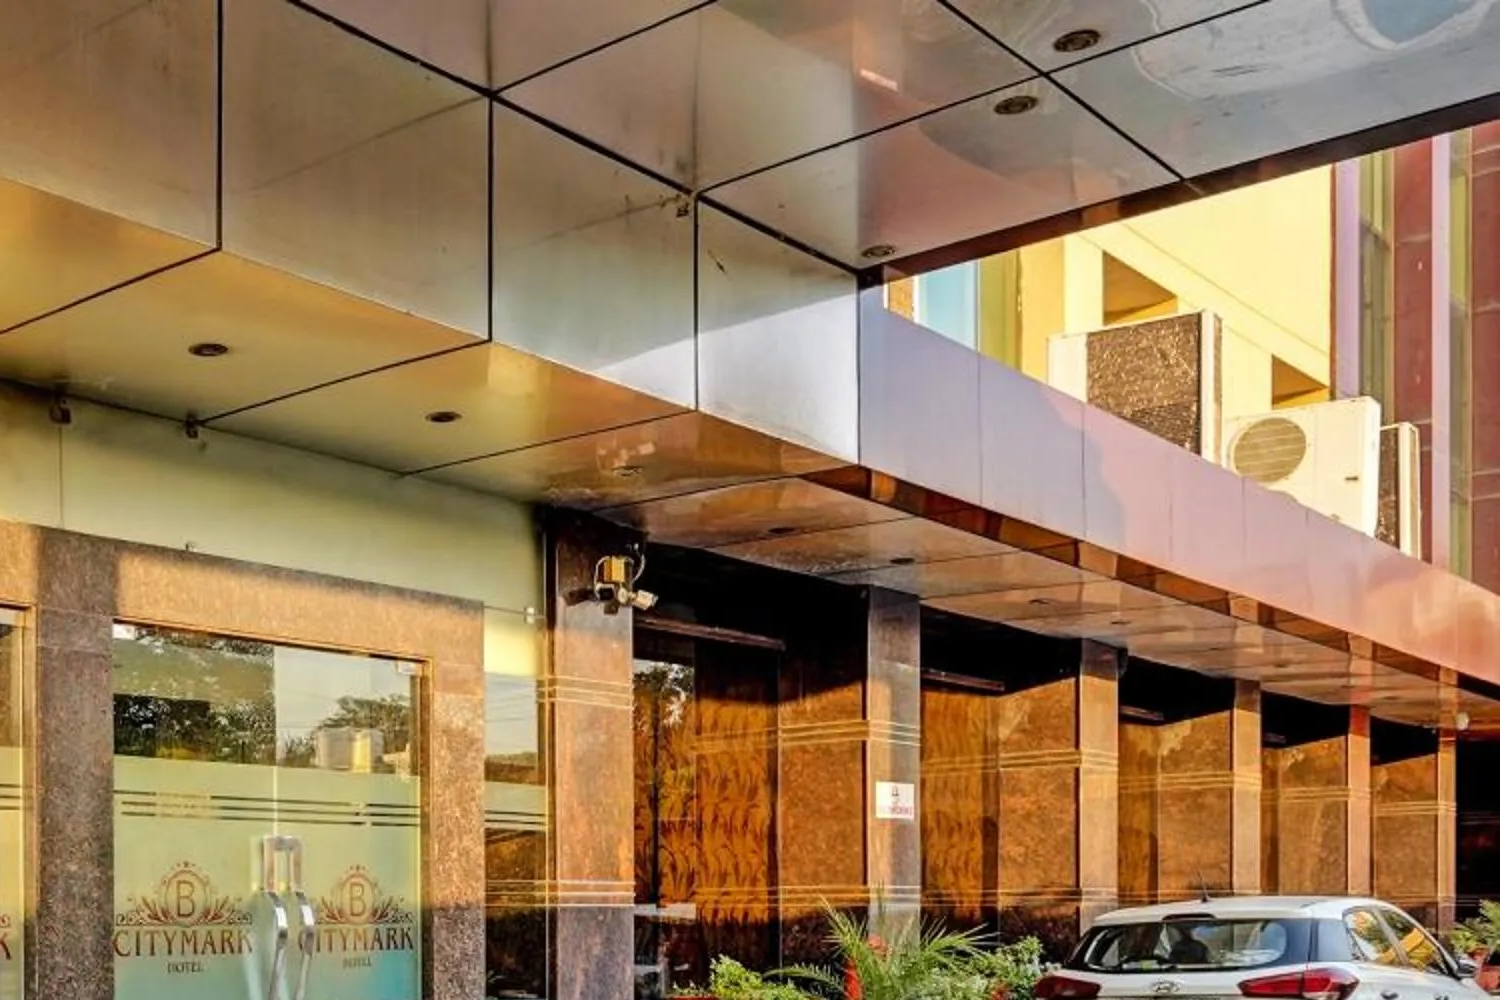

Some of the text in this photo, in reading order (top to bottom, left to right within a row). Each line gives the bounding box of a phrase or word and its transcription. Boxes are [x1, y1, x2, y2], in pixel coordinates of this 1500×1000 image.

[175, 879, 196, 918] B
[347, 881, 366, 917] B
[112, 928, 252, 957] CITYMARK
[167, 961, 204, 974] HOTEL
